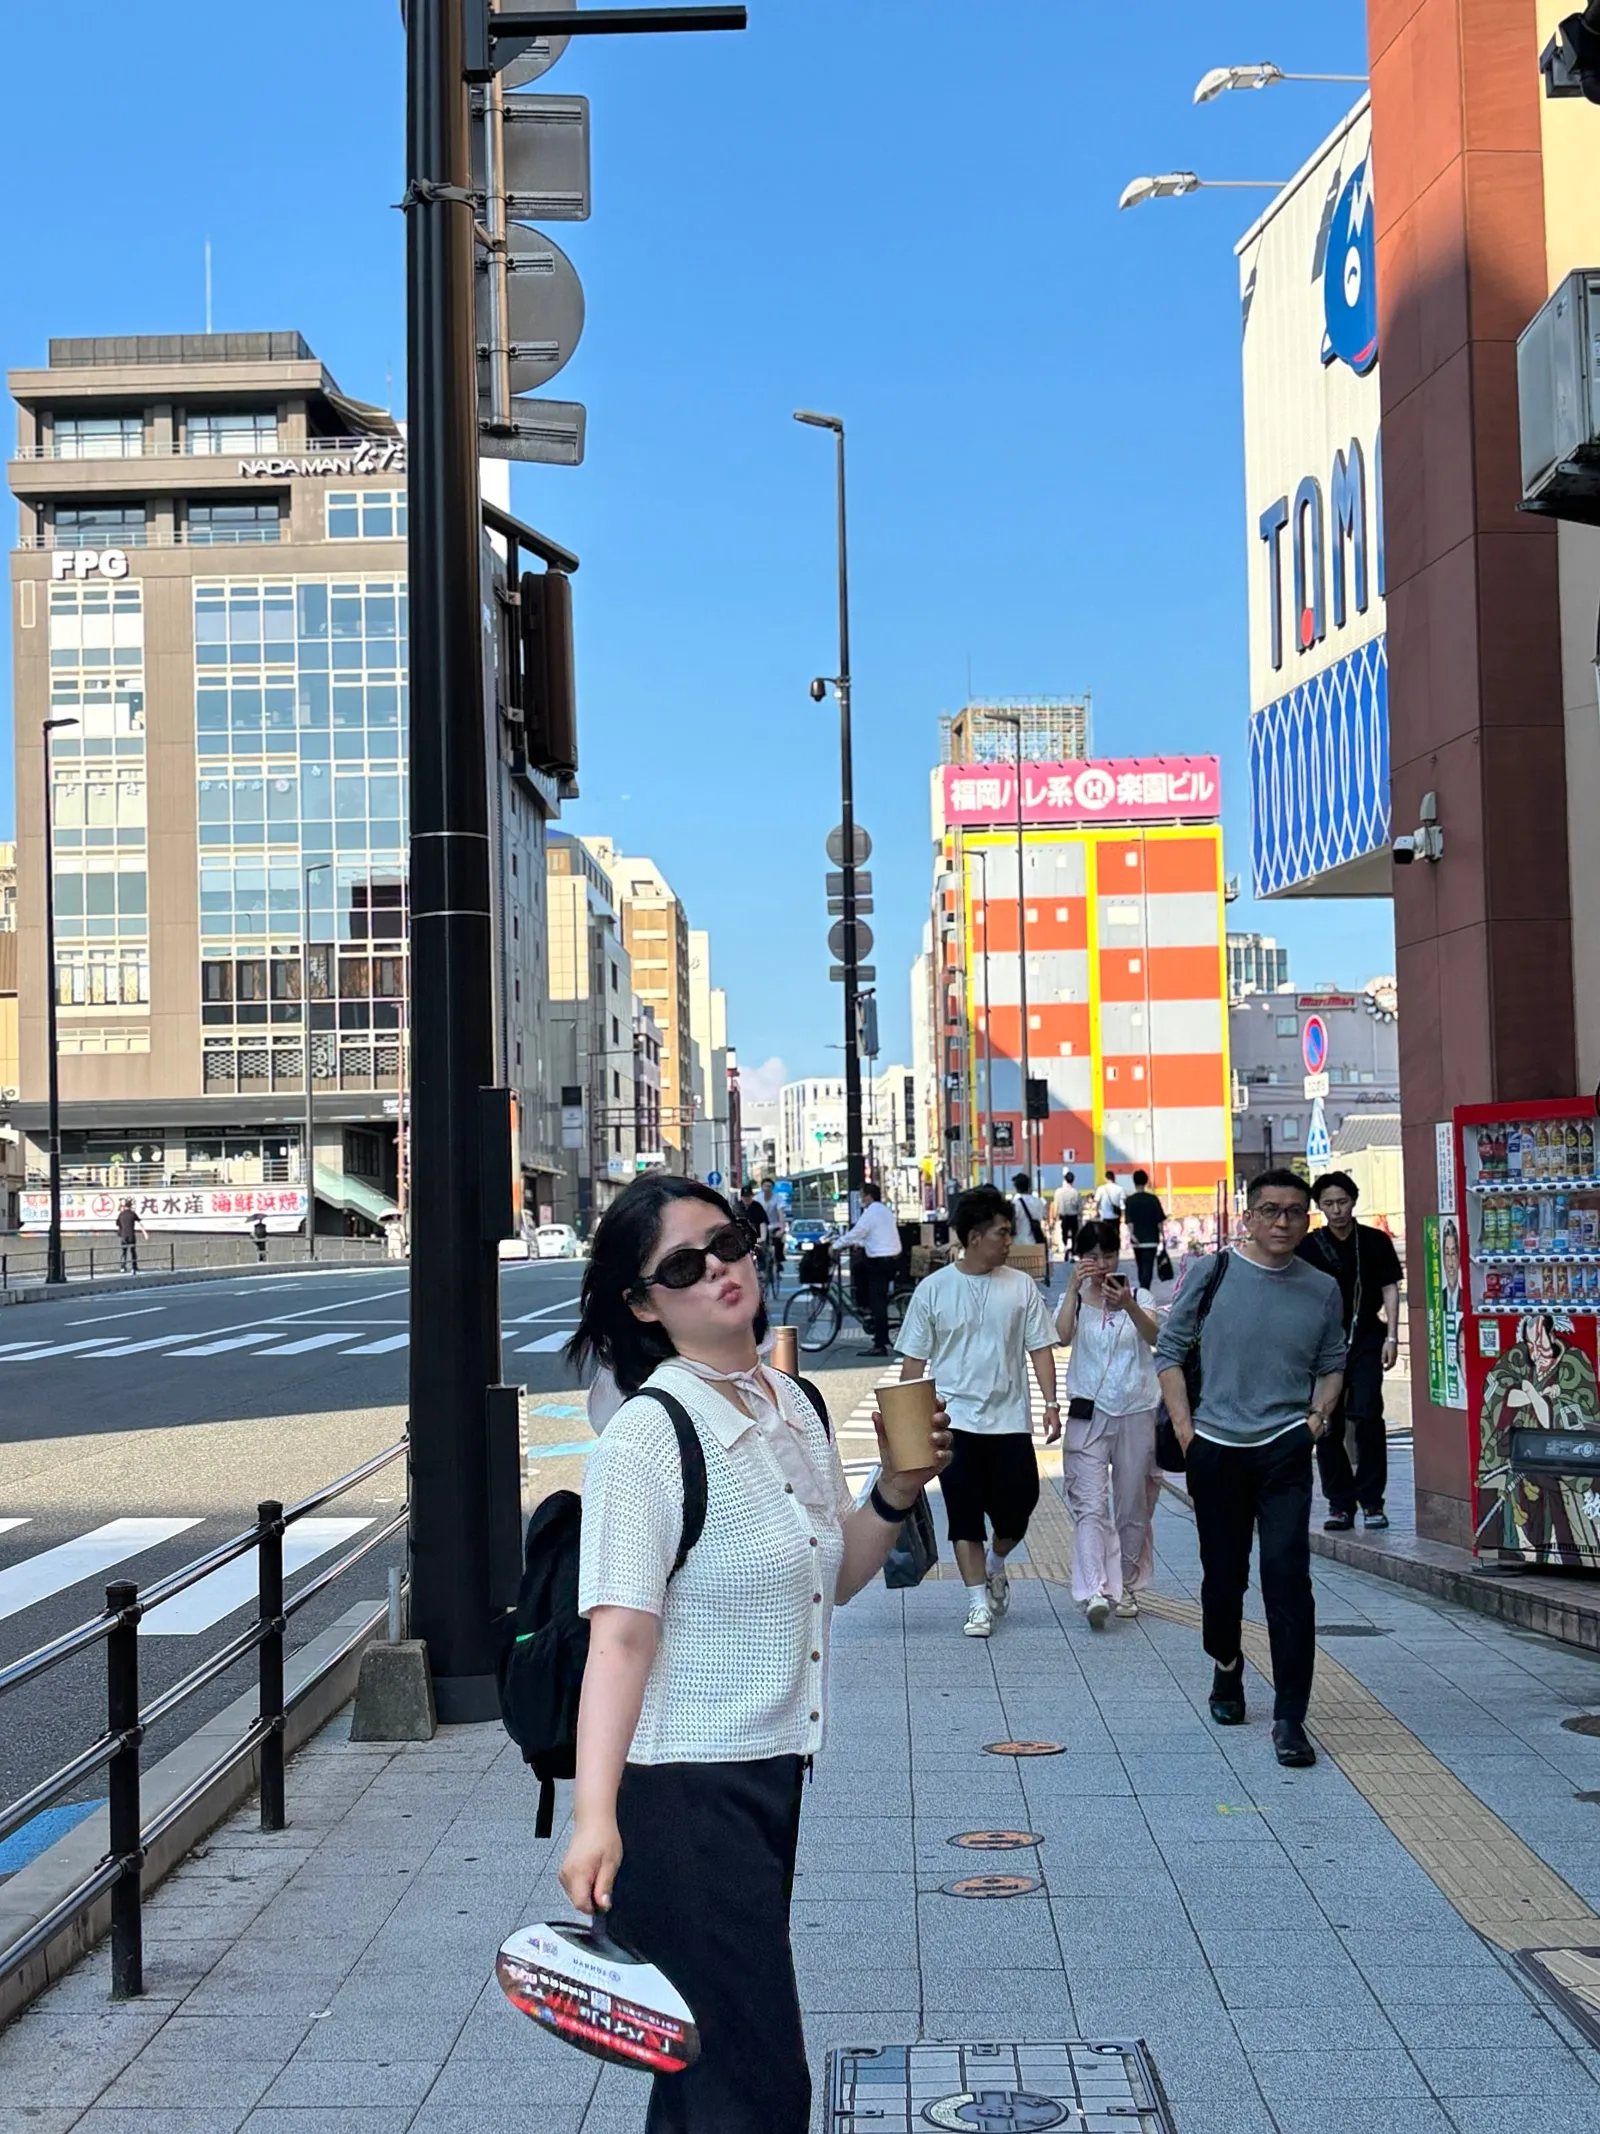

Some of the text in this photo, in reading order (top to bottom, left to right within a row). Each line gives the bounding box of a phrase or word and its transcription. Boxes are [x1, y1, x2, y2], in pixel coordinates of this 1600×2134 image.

[238, 458, 351, 475] NADA MAN
[51, 549, 128, 579] FPG
[1116, 771, 1215, 806] 楽園ビル
